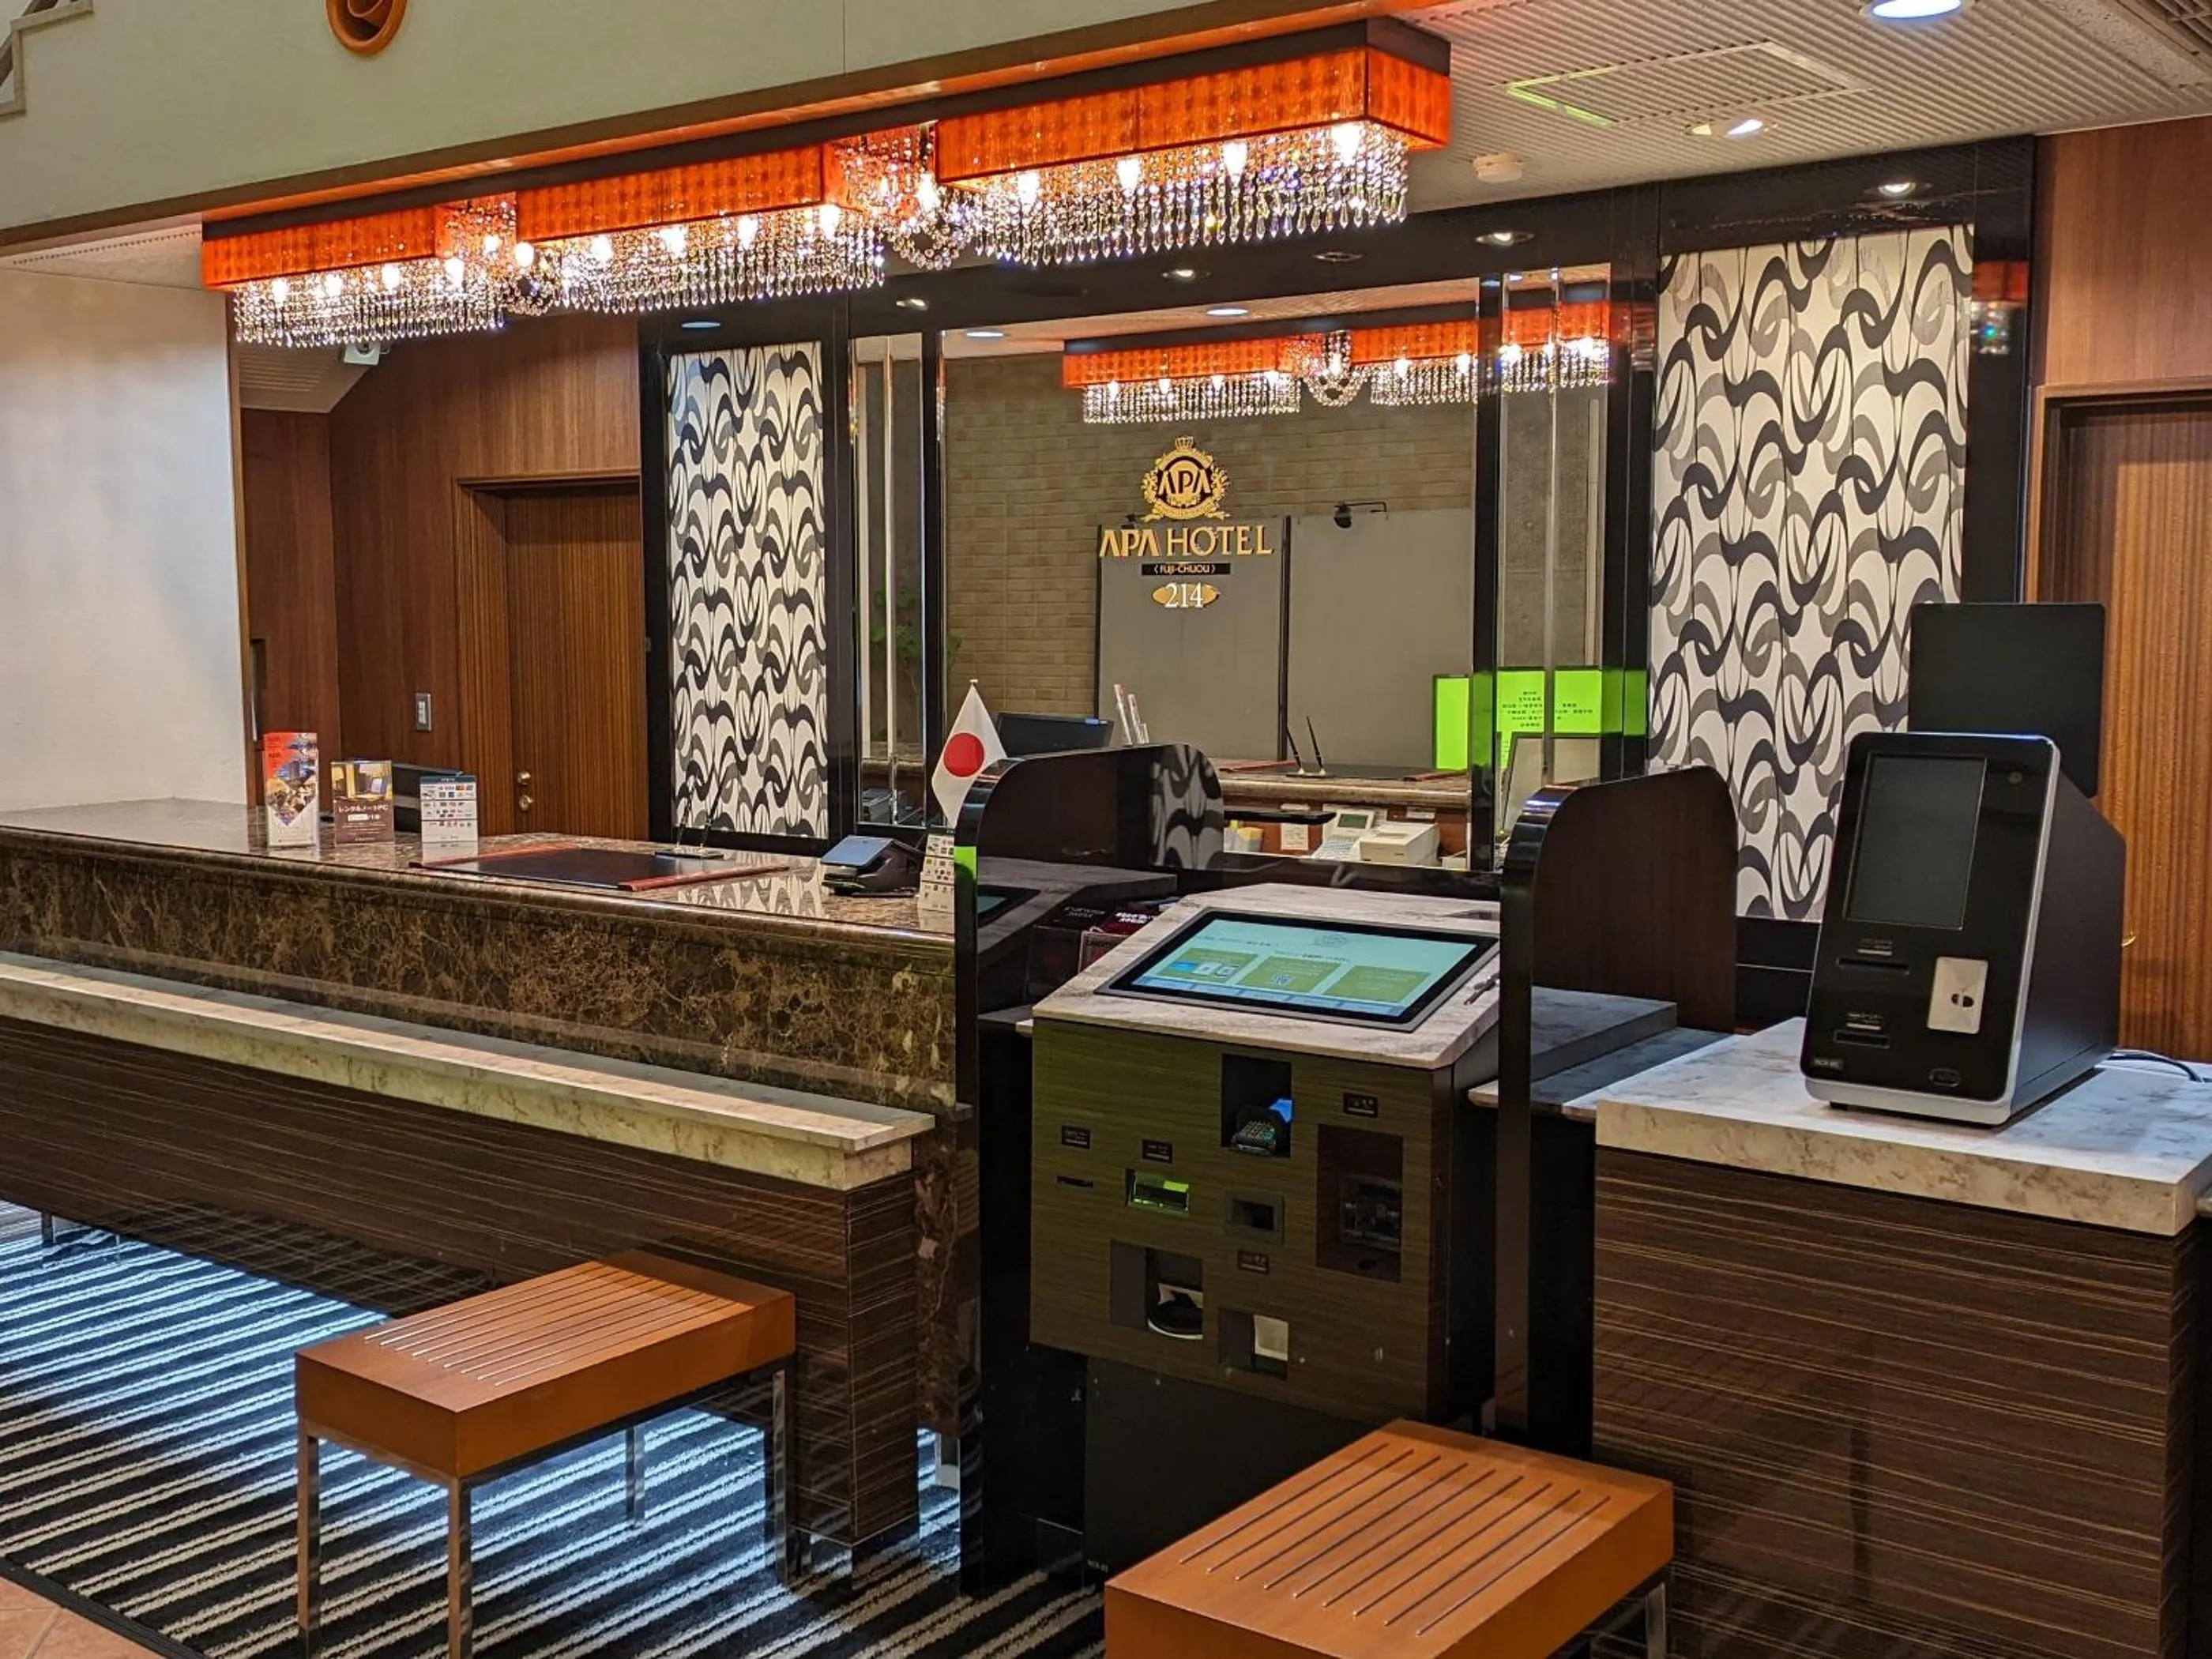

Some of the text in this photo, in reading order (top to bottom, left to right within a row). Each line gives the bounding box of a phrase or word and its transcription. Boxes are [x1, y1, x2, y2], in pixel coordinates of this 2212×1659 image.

[1158, 468, 1211, 495] APA
[1099, 525, 1273, 557] APA HOTEL
[1164, 582, 1203, 608] 214
